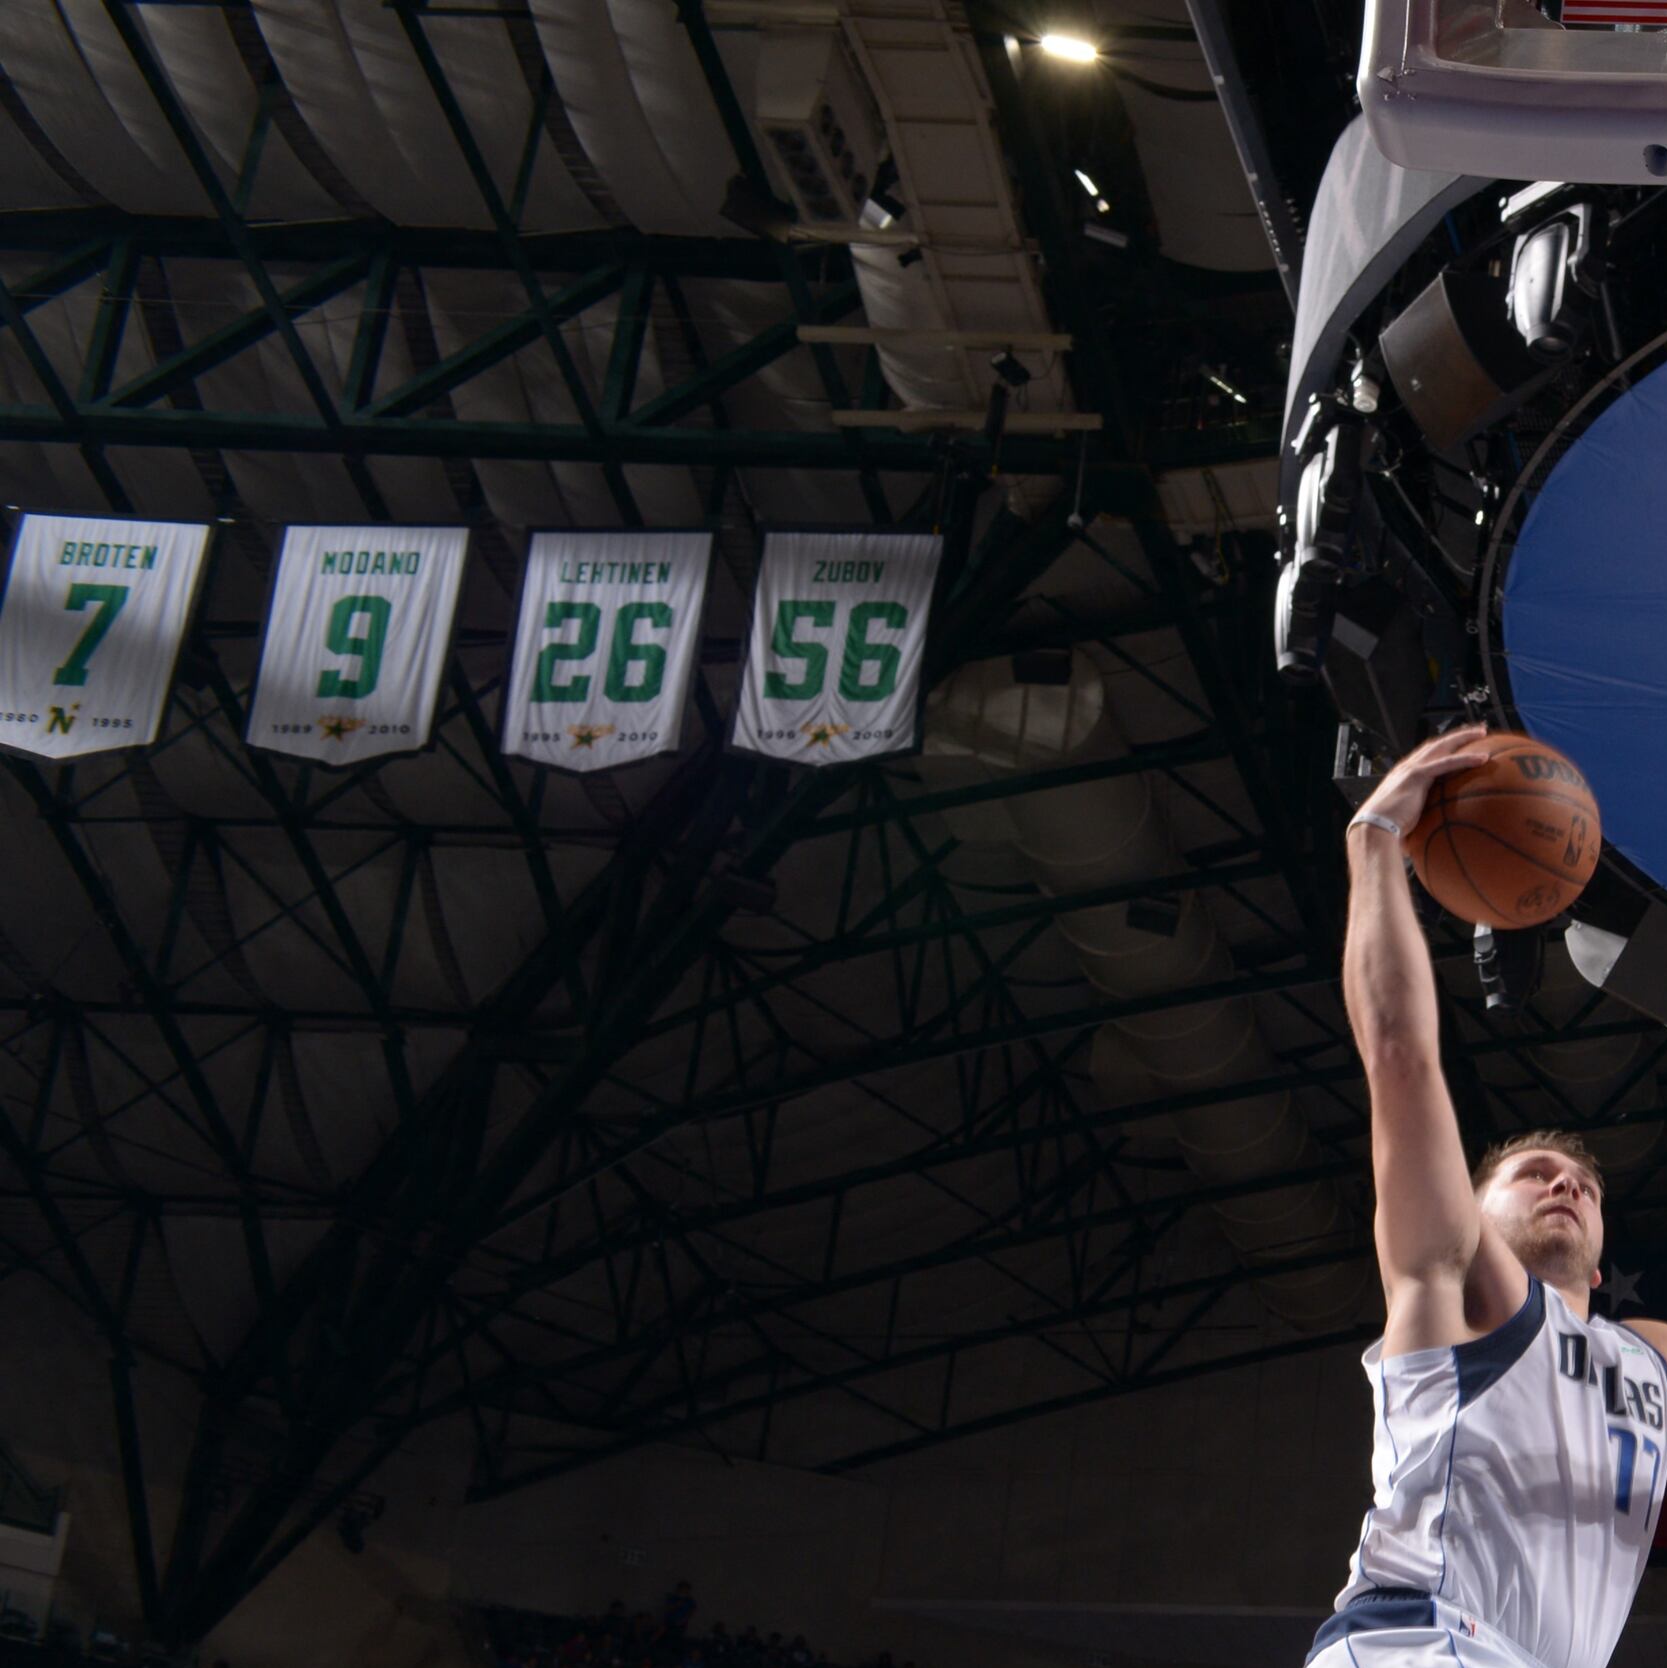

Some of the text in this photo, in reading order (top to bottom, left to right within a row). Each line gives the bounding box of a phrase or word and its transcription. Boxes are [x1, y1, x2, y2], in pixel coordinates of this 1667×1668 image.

[60, 541, 157, 571] BROTEN
[321, 550, 421, 577] MODANO
[560, 560, 672, 586] LEHTINEN
[811, 560, 887, 585] ZUBOV
[53, 584, 129, 686] 7
[316, 595, 392, 700] 9
[529, 600, 673, 704] 26
[763, 599, 908, 704] 56
[91, 717, 134, 731] 1995
[272, 722, 313, 736] 1989
[367, 723, 411, 736] 2010
[522, 730, 561, 744] 1995
[617, 730, 658, 744] 2010
[852, 728, 893, 742] 2009
[1558, 1332, 1664, 1431] DLAS
